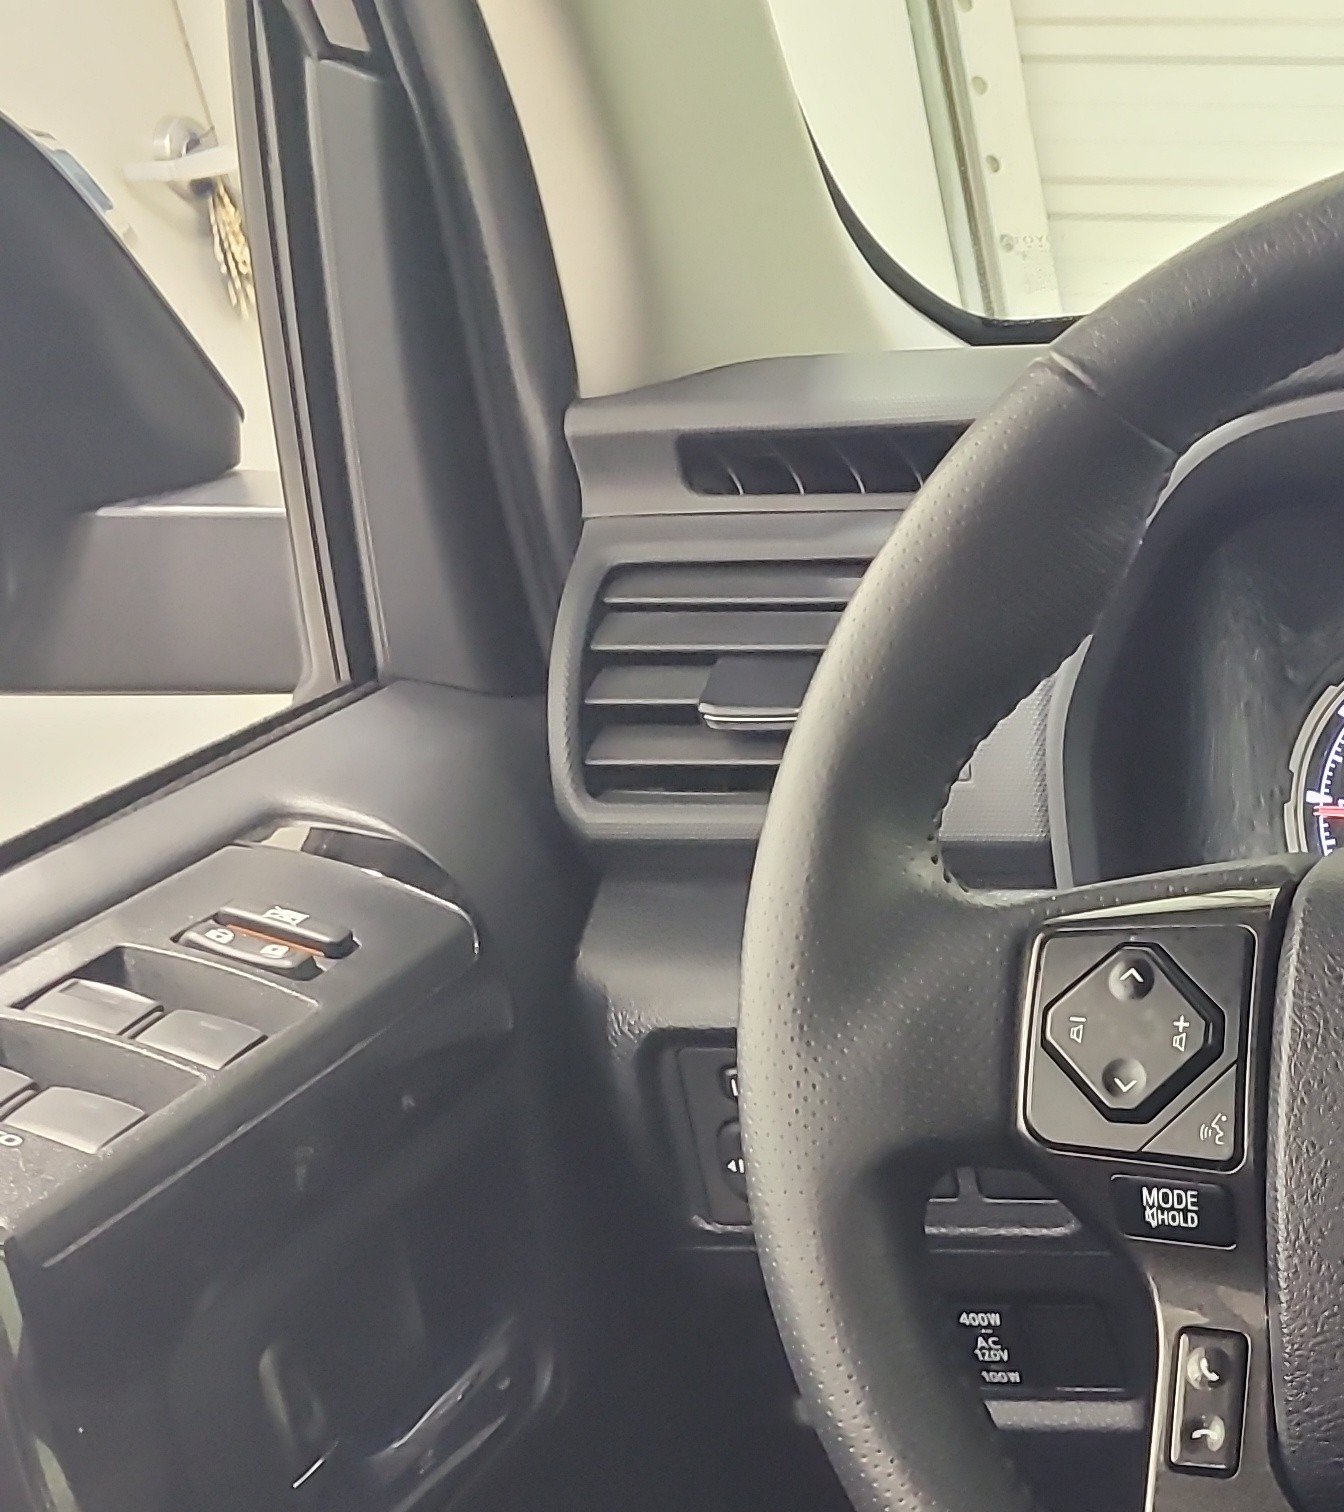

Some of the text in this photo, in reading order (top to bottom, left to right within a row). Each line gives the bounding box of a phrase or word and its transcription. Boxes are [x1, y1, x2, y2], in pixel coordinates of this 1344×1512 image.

[1142, 1186, 1199, 1211] MODE
[1157, 1210, 1199, 1229] HOLD
[959, 1311, 1001, 1327] 400W
[977, 1336, 1002, 1349] AC
[973, 1349, 1009, 1362] 120V
